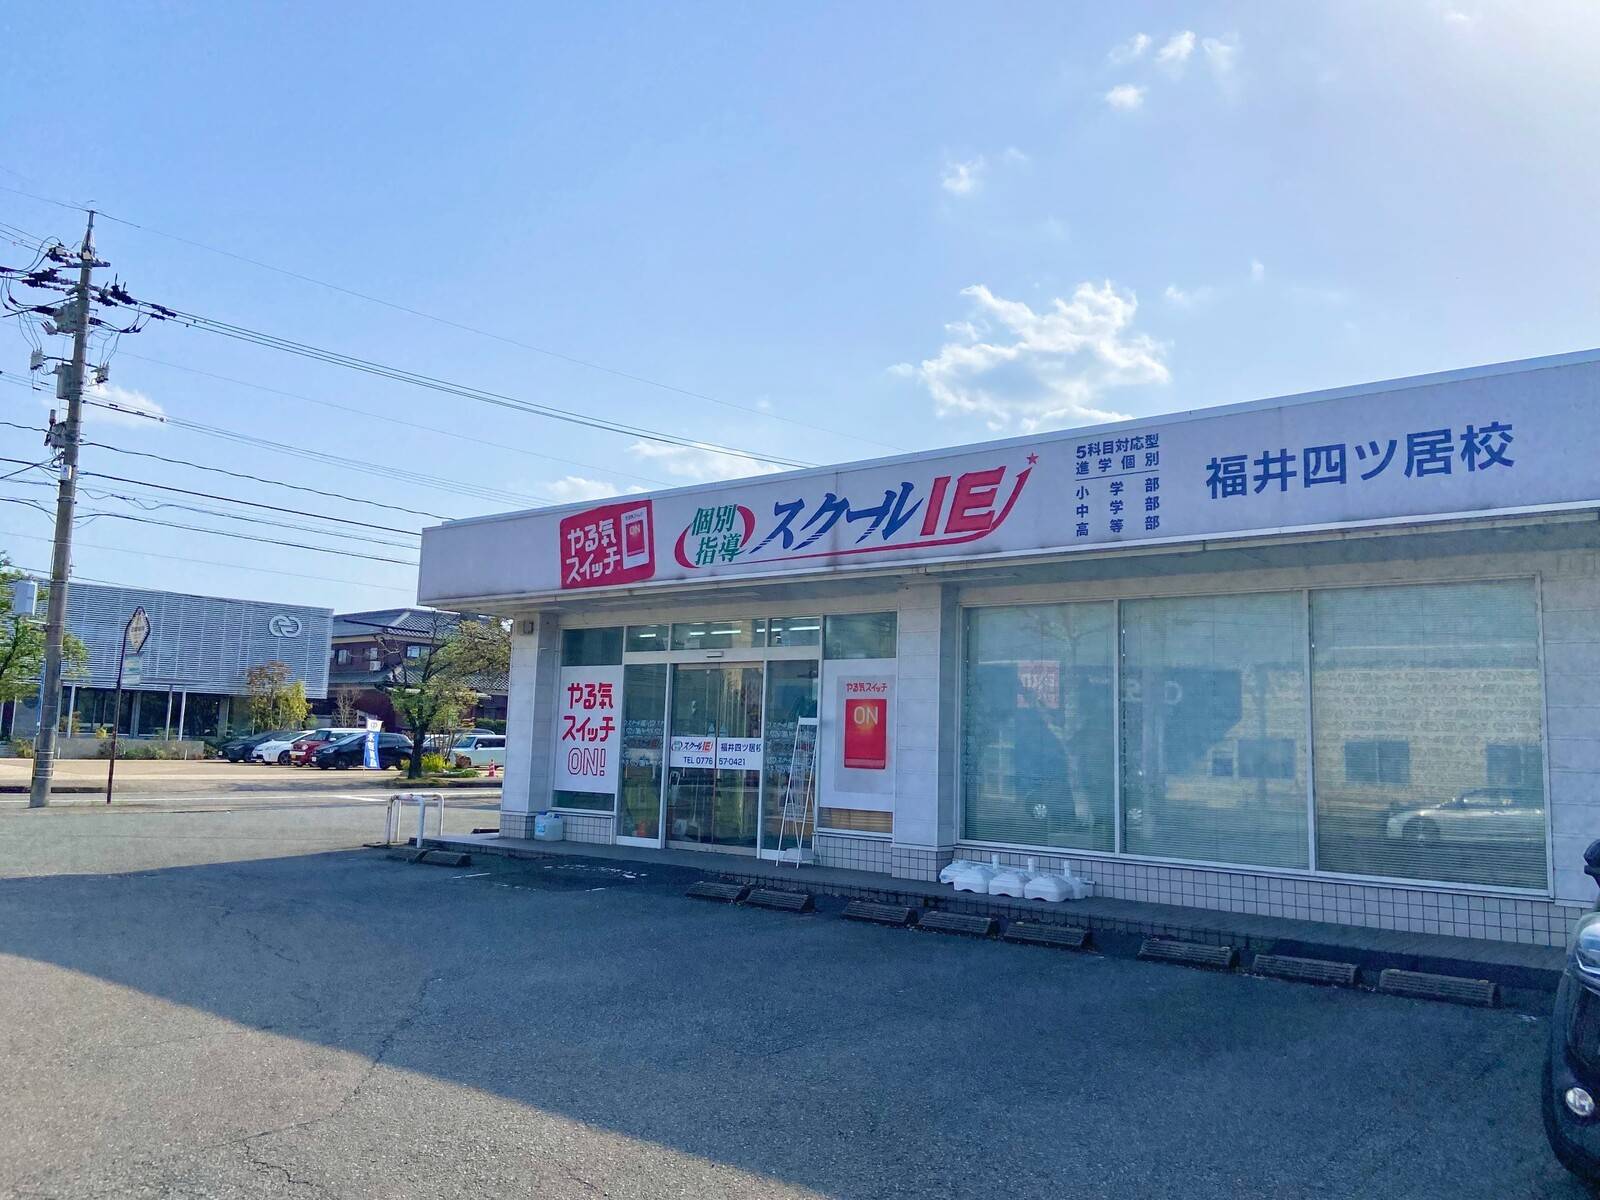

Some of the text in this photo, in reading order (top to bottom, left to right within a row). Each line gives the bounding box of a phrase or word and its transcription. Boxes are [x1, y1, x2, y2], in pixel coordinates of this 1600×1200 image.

[1076, 434, 1160, 459] 5科目対応型
[1076, 451, 1160, 475] 進学個別
[1206, 421, 1515, 500] 福井四ツ居校
[1076, 477, 1160, 500] 小学部
[691, 504, 738, 536] 個別
[1076, 496, 1160, 518] 中学部
[566, 518, 618, 556] やる気
[1076, 515, 1160, 537] 高等部
[695, 533, 742, 566] 指導
[565, 546, 621, 584] スイッチ
[567, 682, 614, 709] やる気
[846, 682, 888, 693] やる気スイッチ
[853, 705, 879, 725] ON
[562, 715, 616, 742] スイッチ
[567, 747, 606, 777] ON!
[684, 756, 695, 765] TEL
[696, 756, 713, 765] 0776
